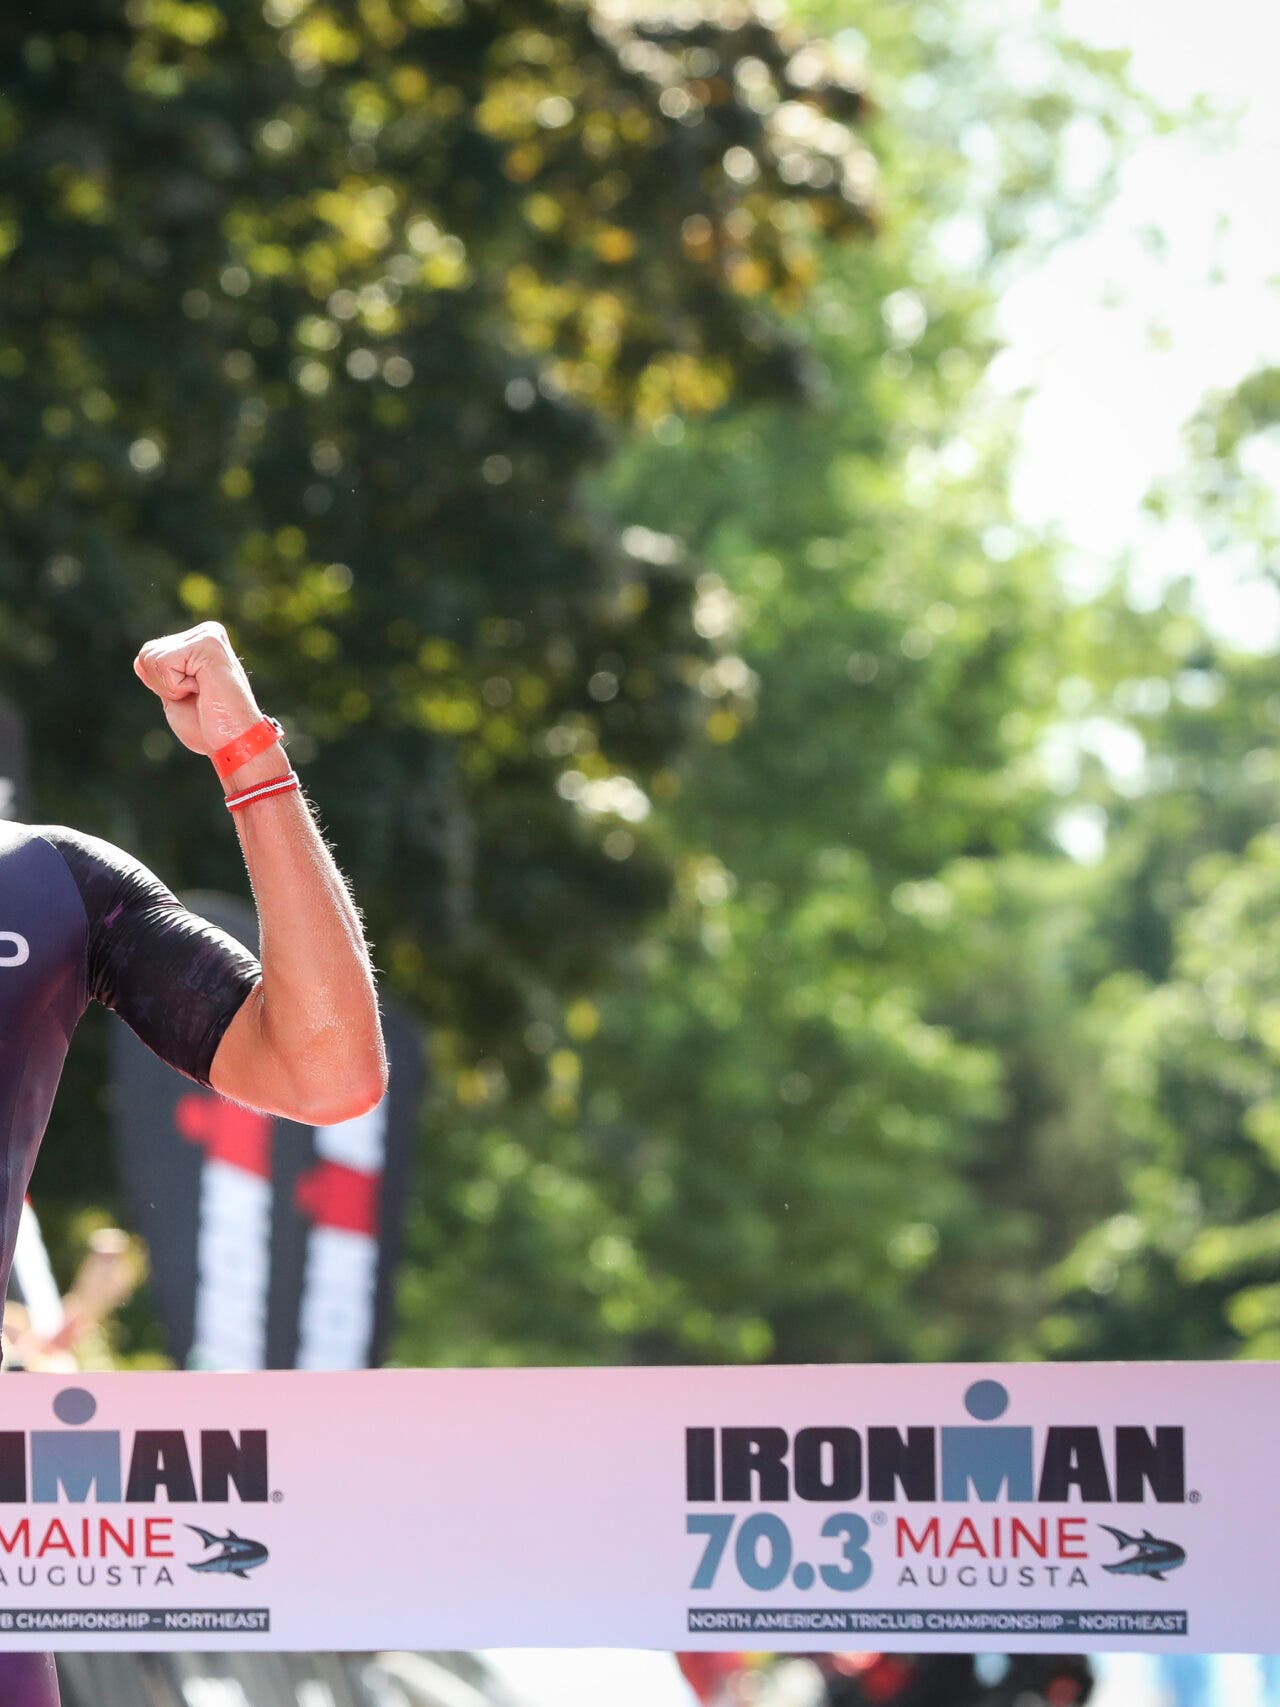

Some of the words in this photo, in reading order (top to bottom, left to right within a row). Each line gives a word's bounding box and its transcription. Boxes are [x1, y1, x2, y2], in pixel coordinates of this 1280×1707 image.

[685, 1425, 1186, 1504] IRONMAN
[686, 1511, 873, 1592] 70.3
[895, 1517, 1089, 1559] MAINE
[897, 1565, 1090, 1588] AUGUSTA
[16, 1612, 151, 1630] CHAMPIONSHIP
[165, 1612, 268, 1629] NORTHEAST
[688, 1613, 752, 1630] NORTH
[753, 1613, 847, 1629] AMERICAN
[849, 1612, 924, 1629] TRICLUB
[925, 1612, 1065, 1630] CHAMPIONSHIP
[1078, 1613, 1187, 1631] NORTHEAST
